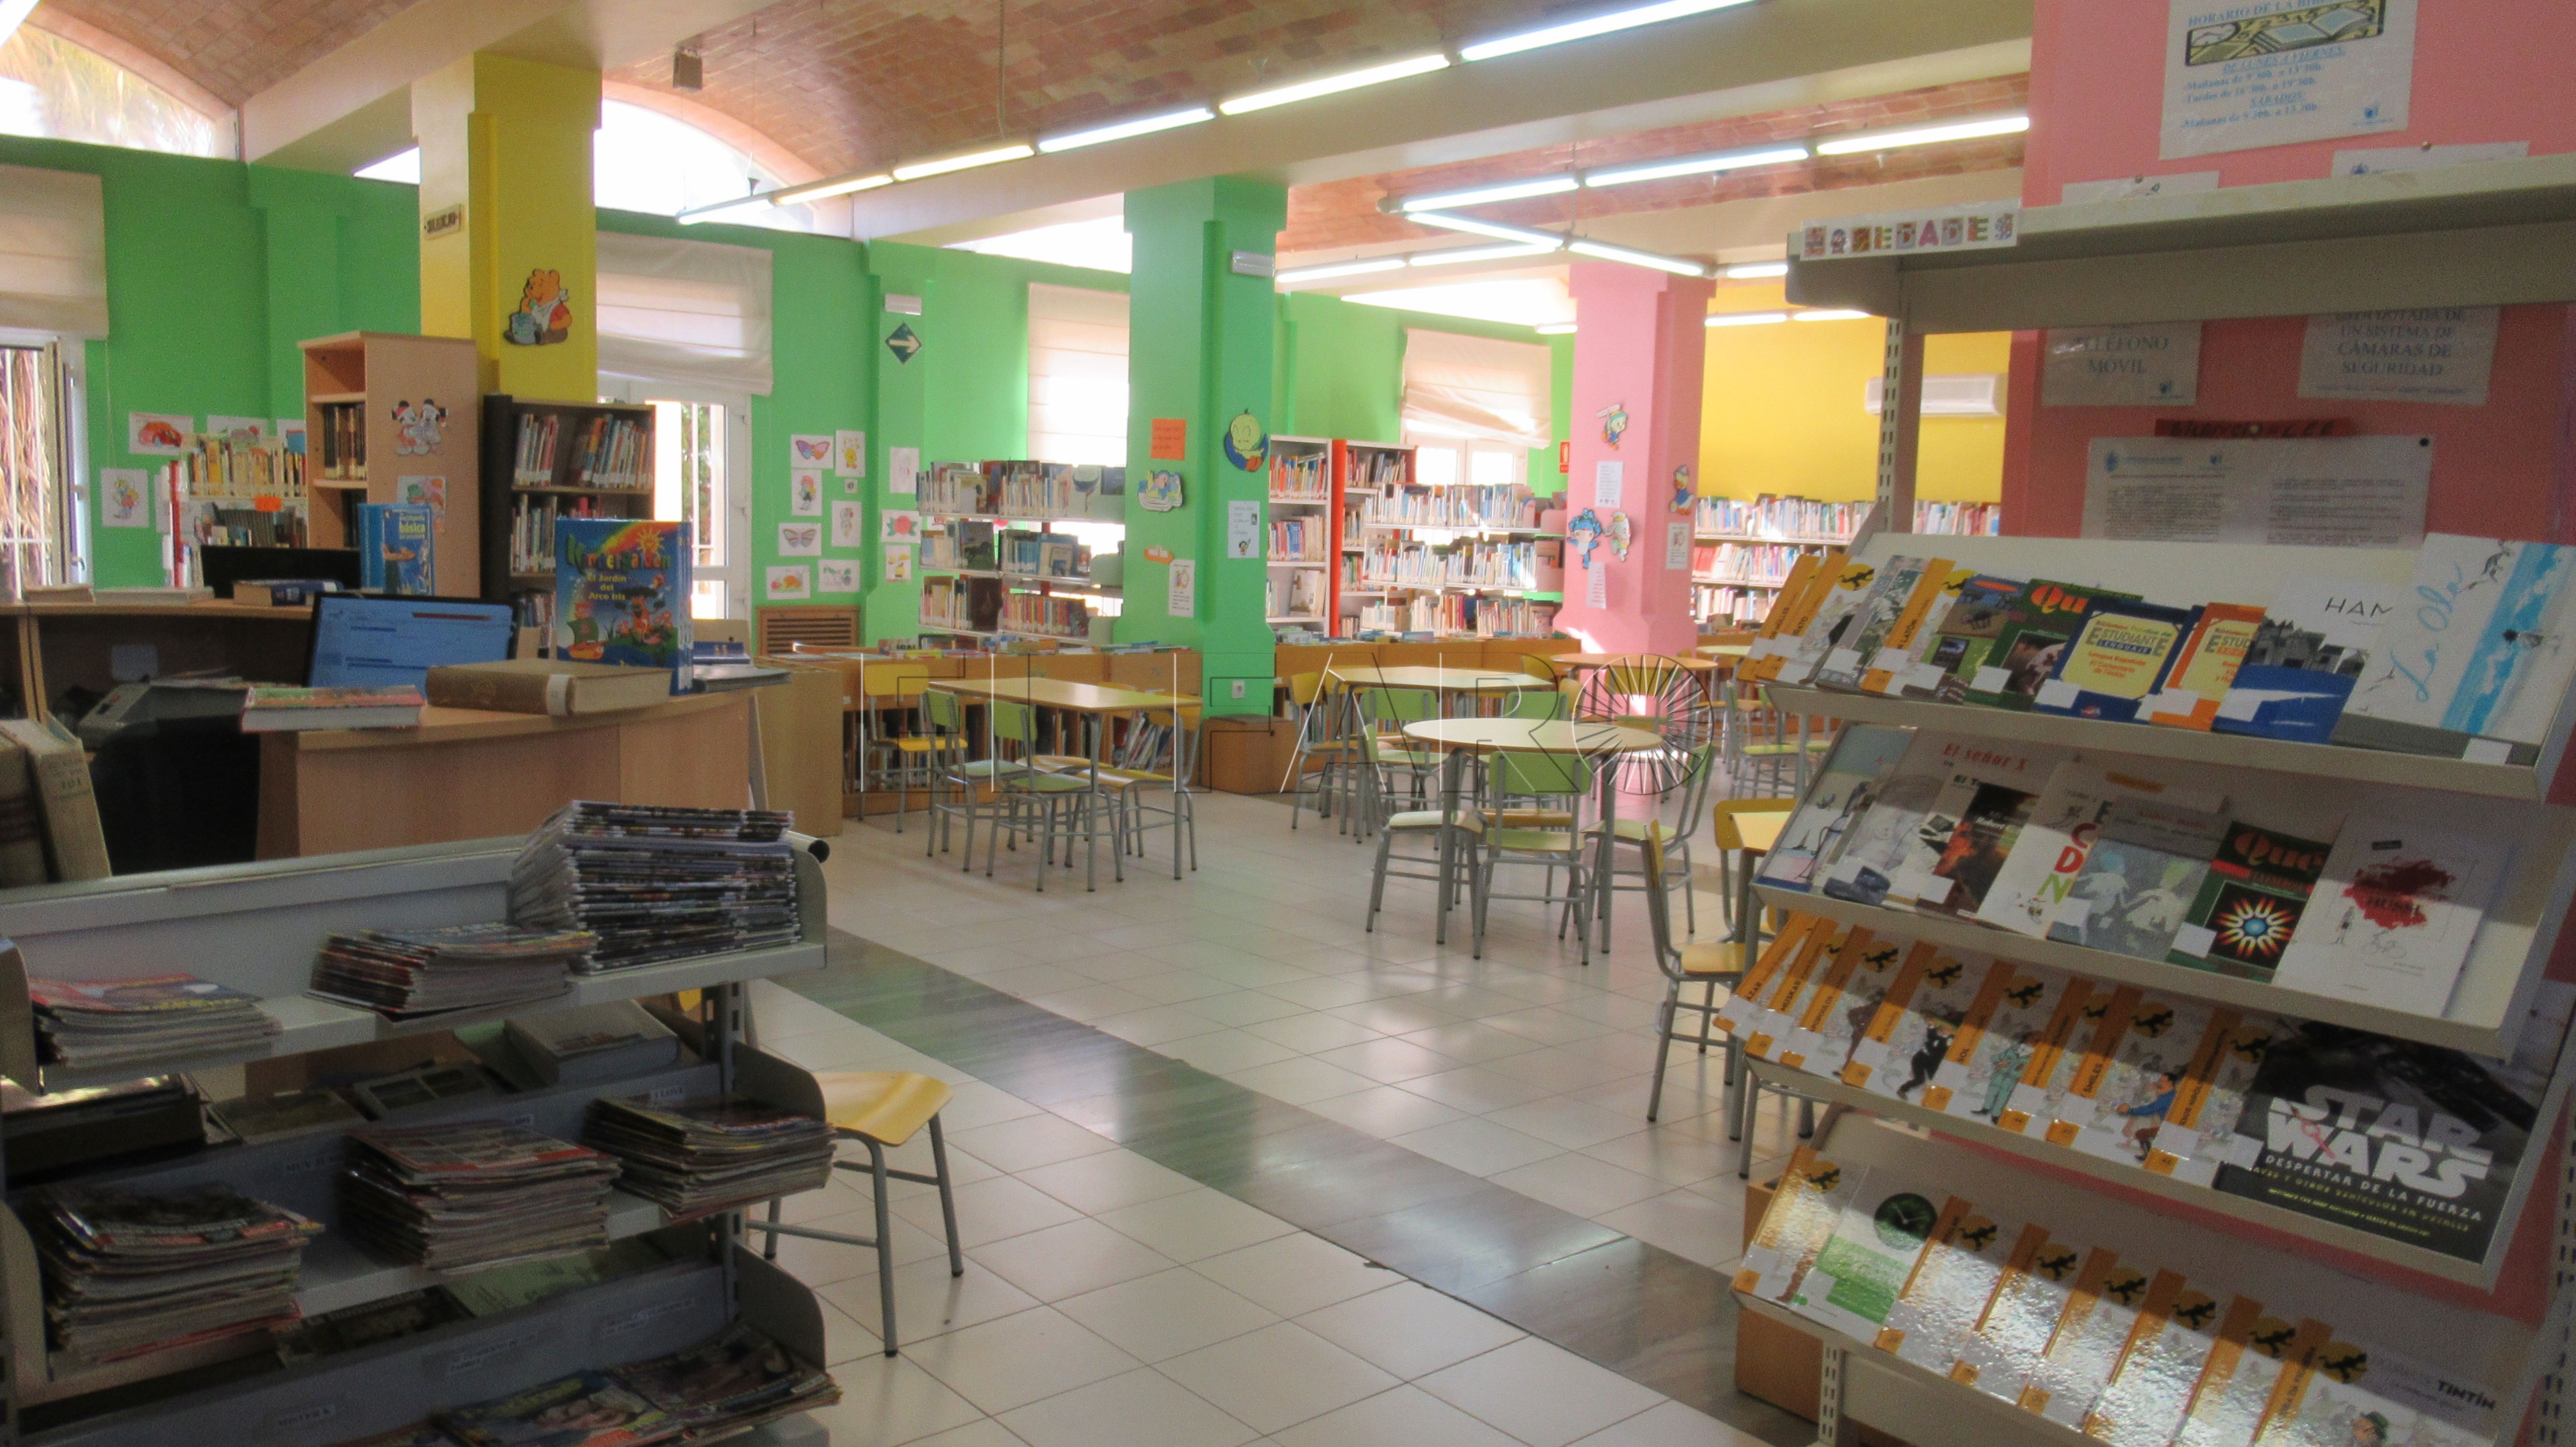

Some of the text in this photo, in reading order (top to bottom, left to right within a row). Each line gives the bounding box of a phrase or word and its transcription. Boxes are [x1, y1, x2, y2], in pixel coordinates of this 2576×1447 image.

[2267, 1084, 2494, 1166] STAR
[2267, 1112, 2491, 1199] WARS
[2264, 1154, 2482, 1221] DESPERTAR DE LA FUERZA
[2437, 1378, 2496, 1411] TINTÍN
